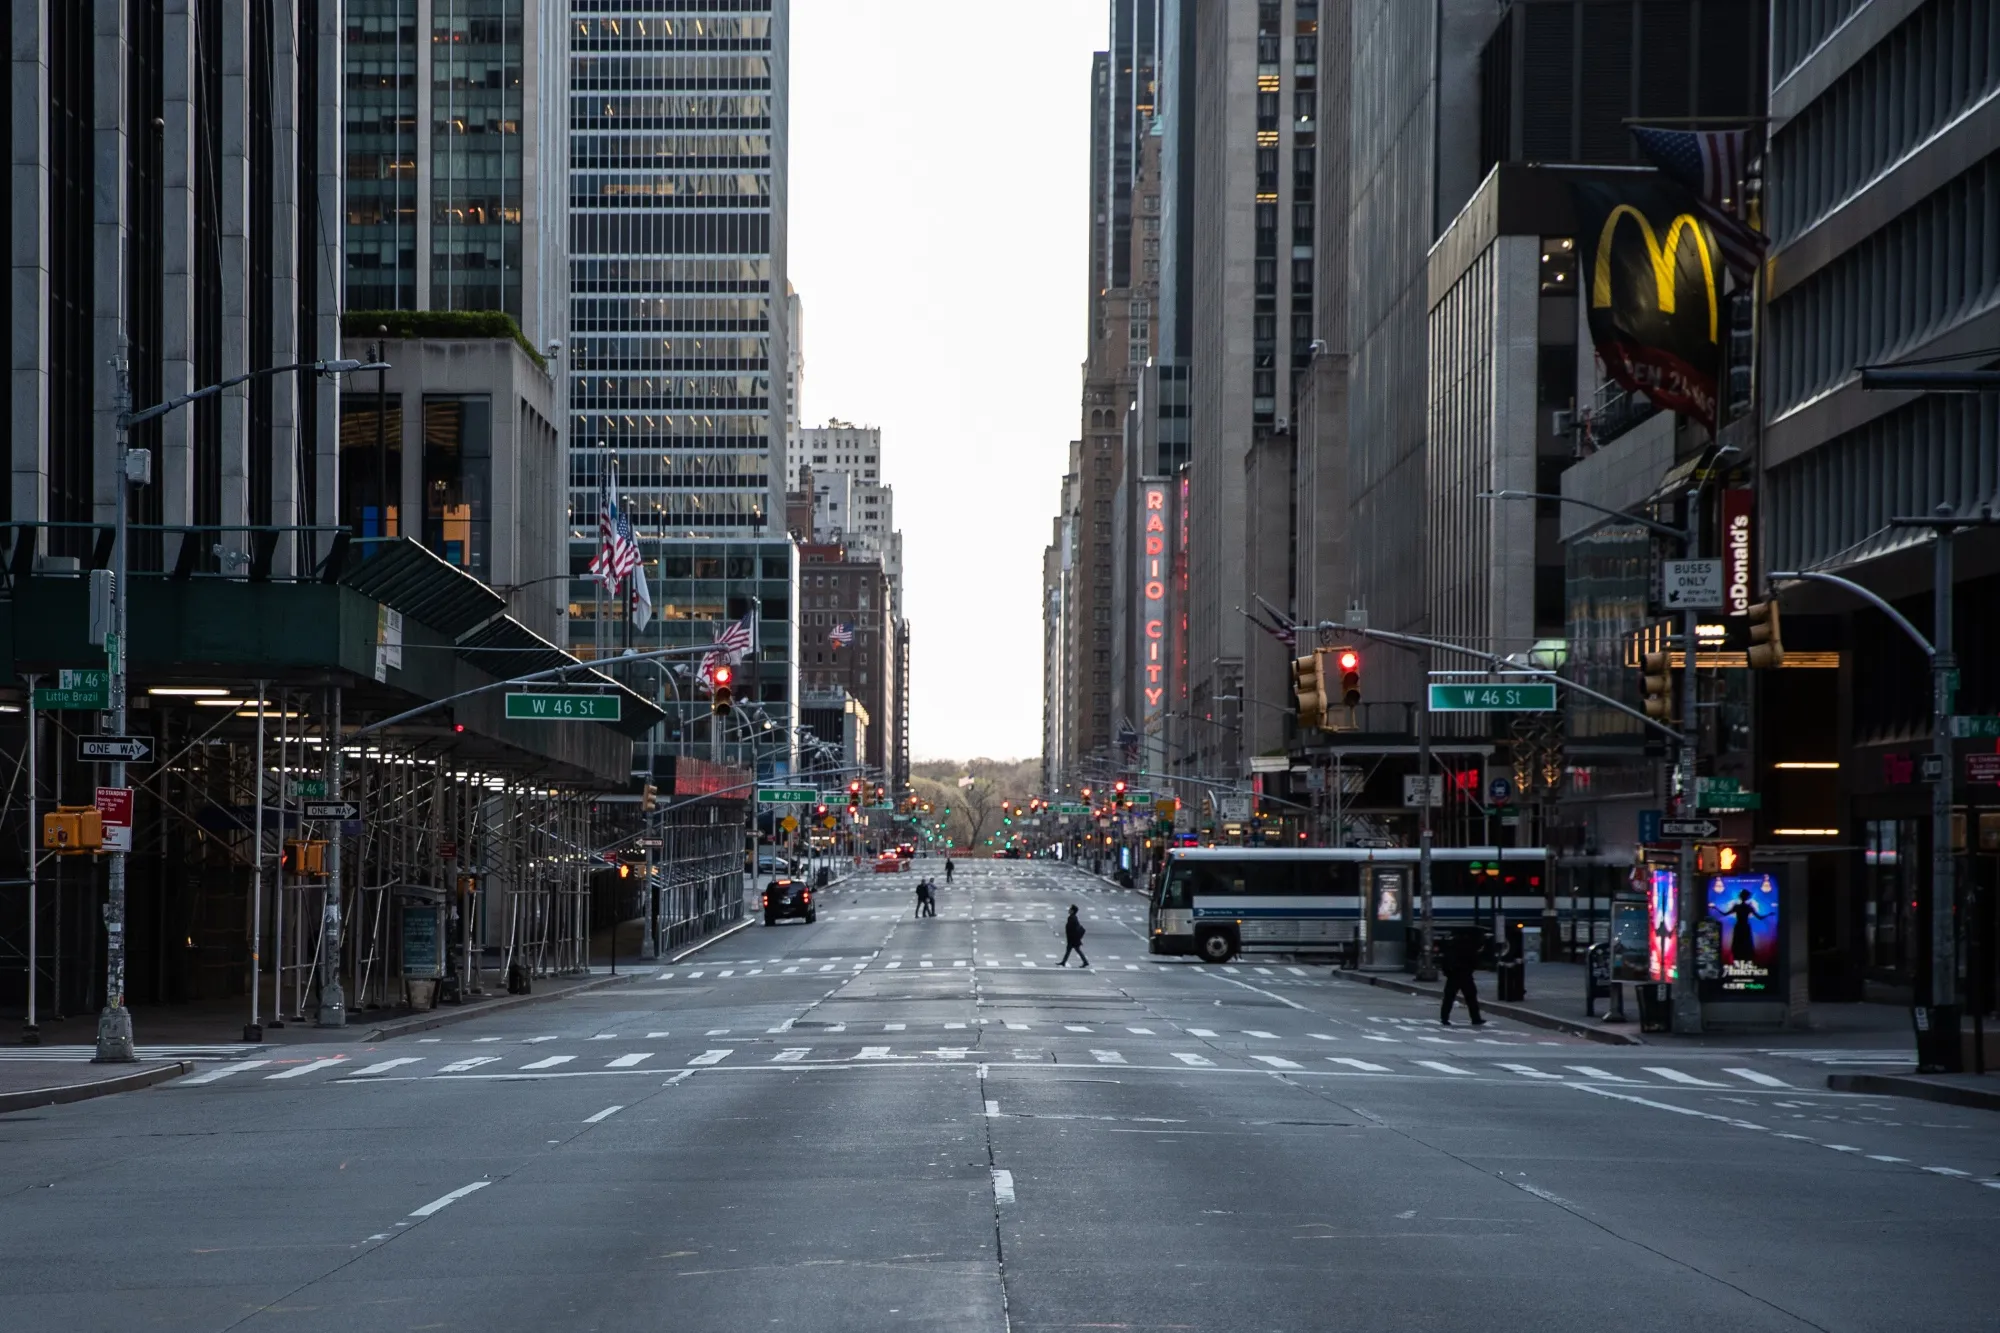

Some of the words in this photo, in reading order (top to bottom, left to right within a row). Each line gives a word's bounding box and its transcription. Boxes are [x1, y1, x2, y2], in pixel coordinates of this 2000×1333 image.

[1144, 490, 1165, 601] RADIO
[1674, 563, 1712, 574] BUSES
[1678, 576, 1708, 586] ONLY
[1144, 619, 1164, 706] CITY
[73, 672, 82, 687] W
[85, 672, 98, 688] 46
[46, 692, 69, 702] Little
[72, 692, 98, 702] Brazil
[1464, 690, 1476, 705] W
[1480, 690, 1500, 705] 46
[1506, 690, 1522, 705] St
[532, 700, 546, 714] W
[554, 700, 572, 715] 46
[580, 700, 594, 715] St
[1971, 720, 1980, 733] W
[1984, 720, 2000, 735] 46
[89, 744, 110, 754] ONE
[120, 744, 142, 755] WAY
[298, 783, 304, 794] W
[306, 784, 317, 795] 46
